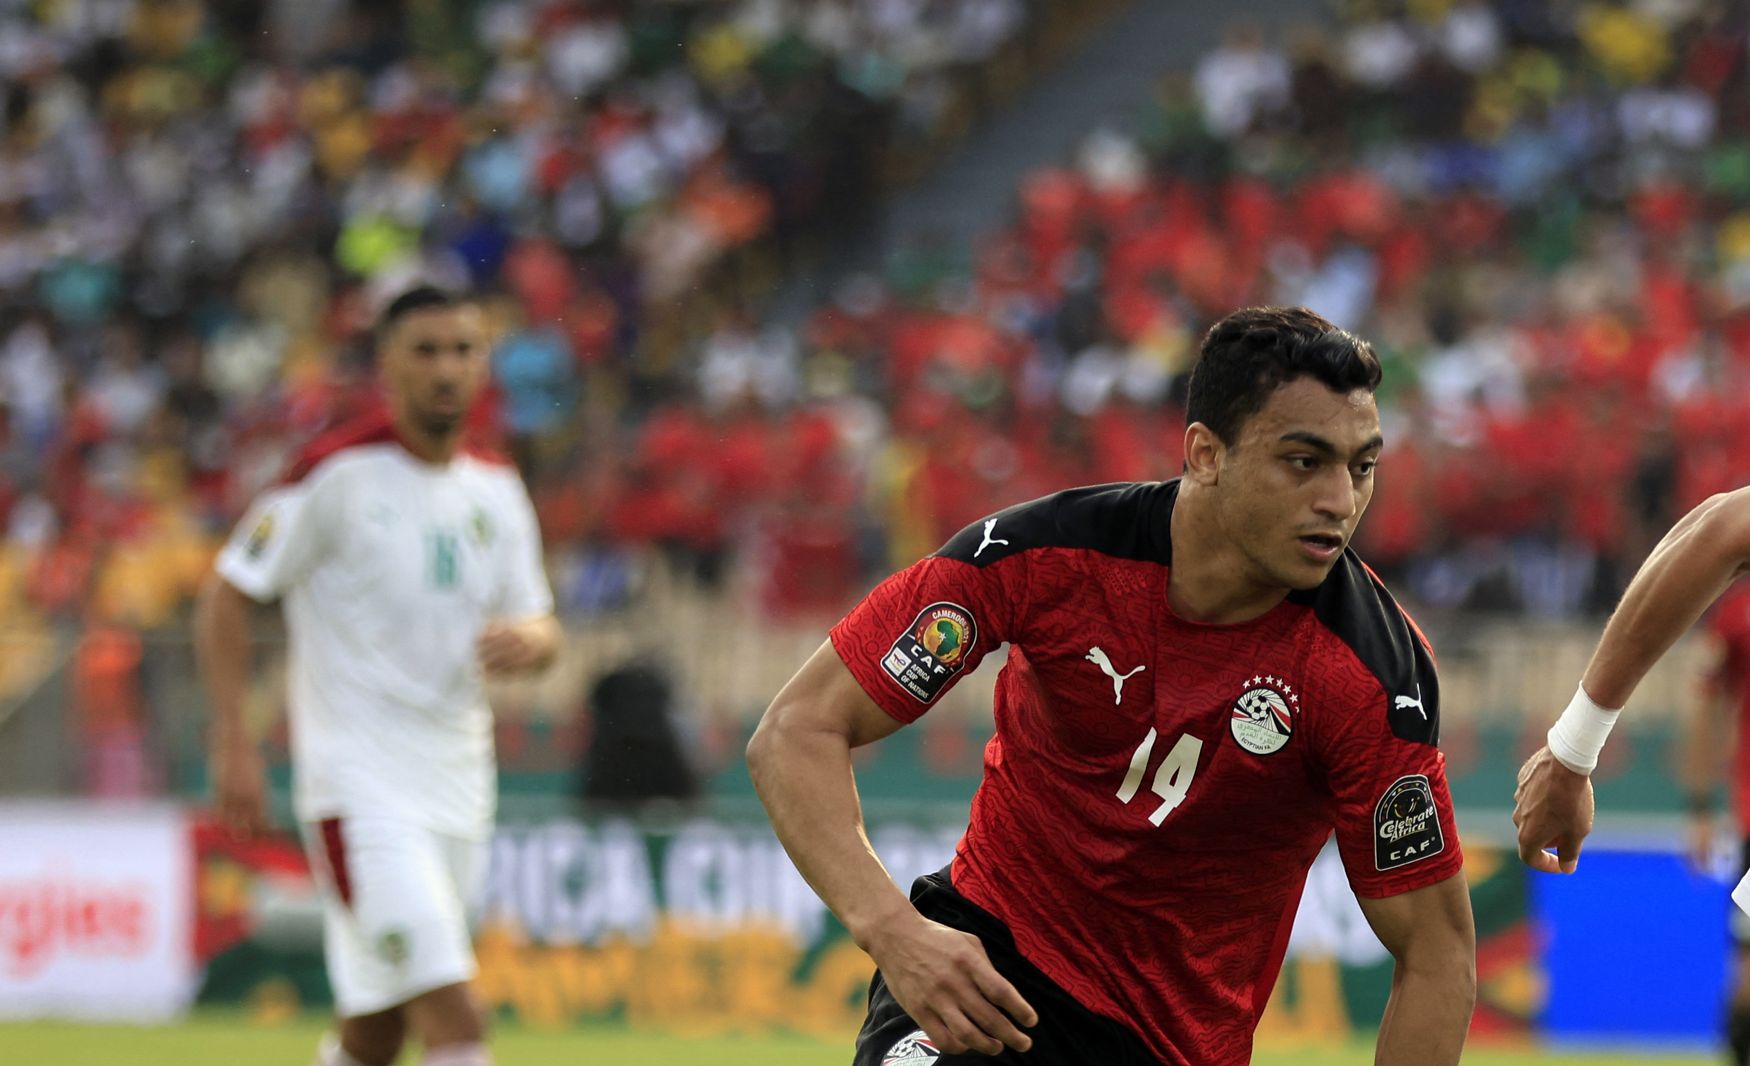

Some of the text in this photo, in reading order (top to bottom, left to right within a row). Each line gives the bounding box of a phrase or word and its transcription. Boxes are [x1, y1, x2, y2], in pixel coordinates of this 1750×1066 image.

[910, 644, 947, 674] CAF
[905, 669, 919, 680] CUP
[910, 663, 931, 682] AFRICA
[900, 674, 930, 699] OF NATIONS
[1241, 736, 1264, 750] EGYPTIAN
[1115, 726, 1204, 828] 14
[1379, 805, 1434, 839] Celebrate
[1389, 821, 1426, 844] Africa
[1390, 839, 1431, 861] CAF
